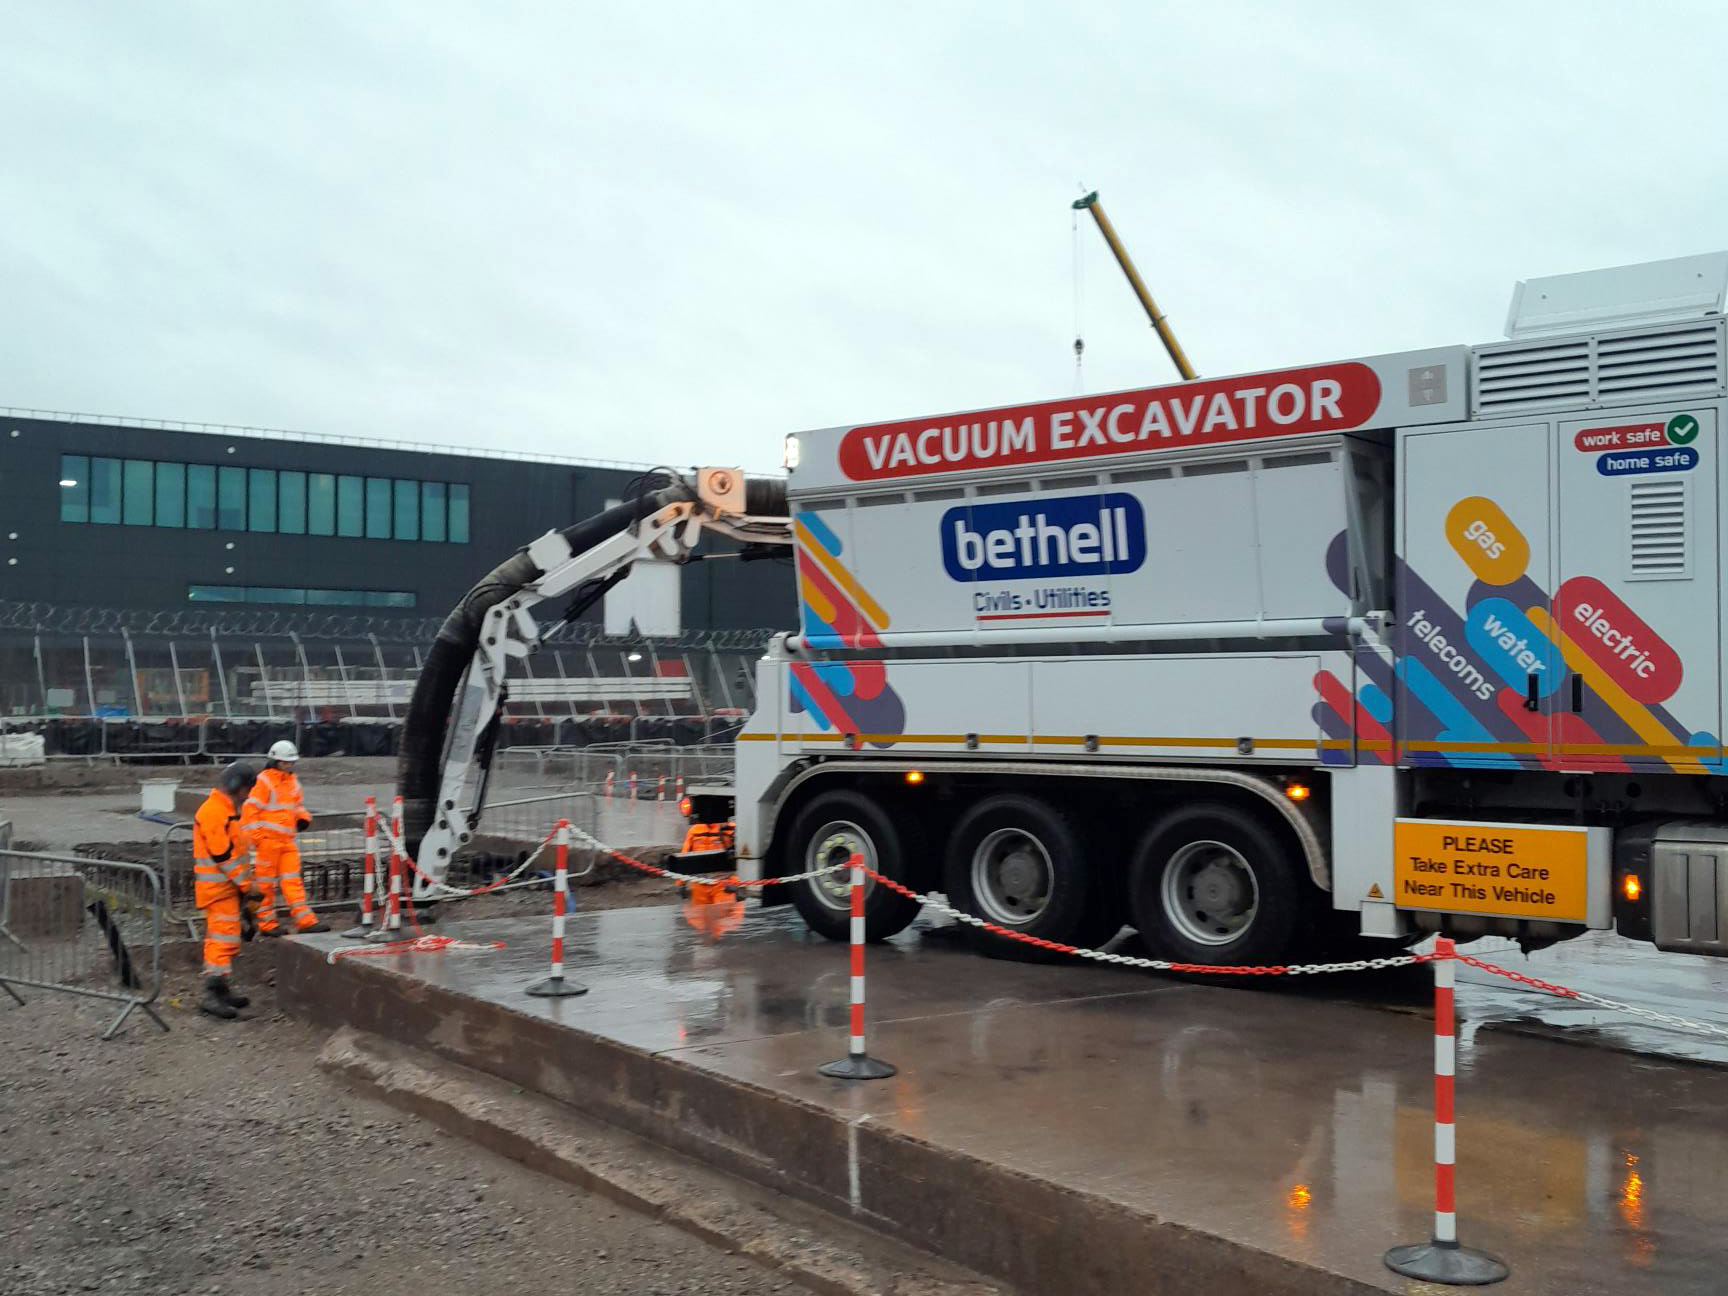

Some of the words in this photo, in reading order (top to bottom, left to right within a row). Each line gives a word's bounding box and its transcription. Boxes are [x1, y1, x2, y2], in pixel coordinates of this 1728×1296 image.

[863, 417, 1037, 470] VACUUM
[1050, 379, 1344, 449] EXCAVATOR
[1583, 431, 1621, 448] work
[1626, 427, 1661, 444] safe
[1606, 455, 1650, 471] home
[1655, 452, 1690, 467] safe
[954, 507, 1129, 570] bethell
[1464, 520, 1505, 559] gas
[973, 588, 1022, 613] Civils
[1034, 586, 1111, 610] Utilities
[1407, 609, 1495, 700] telecoms
[1483, 614, 1546, 674] water
[1574, 603, 1656, 678] electric
[1443, 836, 1514, 854] PLEASE
[1410, 857, 1447, 873] Take
[1454, 860, 1500, 877] Extra
[1507, 863, 1549, 880] Care
[1404, 880, 1443, 897] Near
[1450, 882, 1487, 900] This
[1493, 885, 1555, 904] Vehicle
